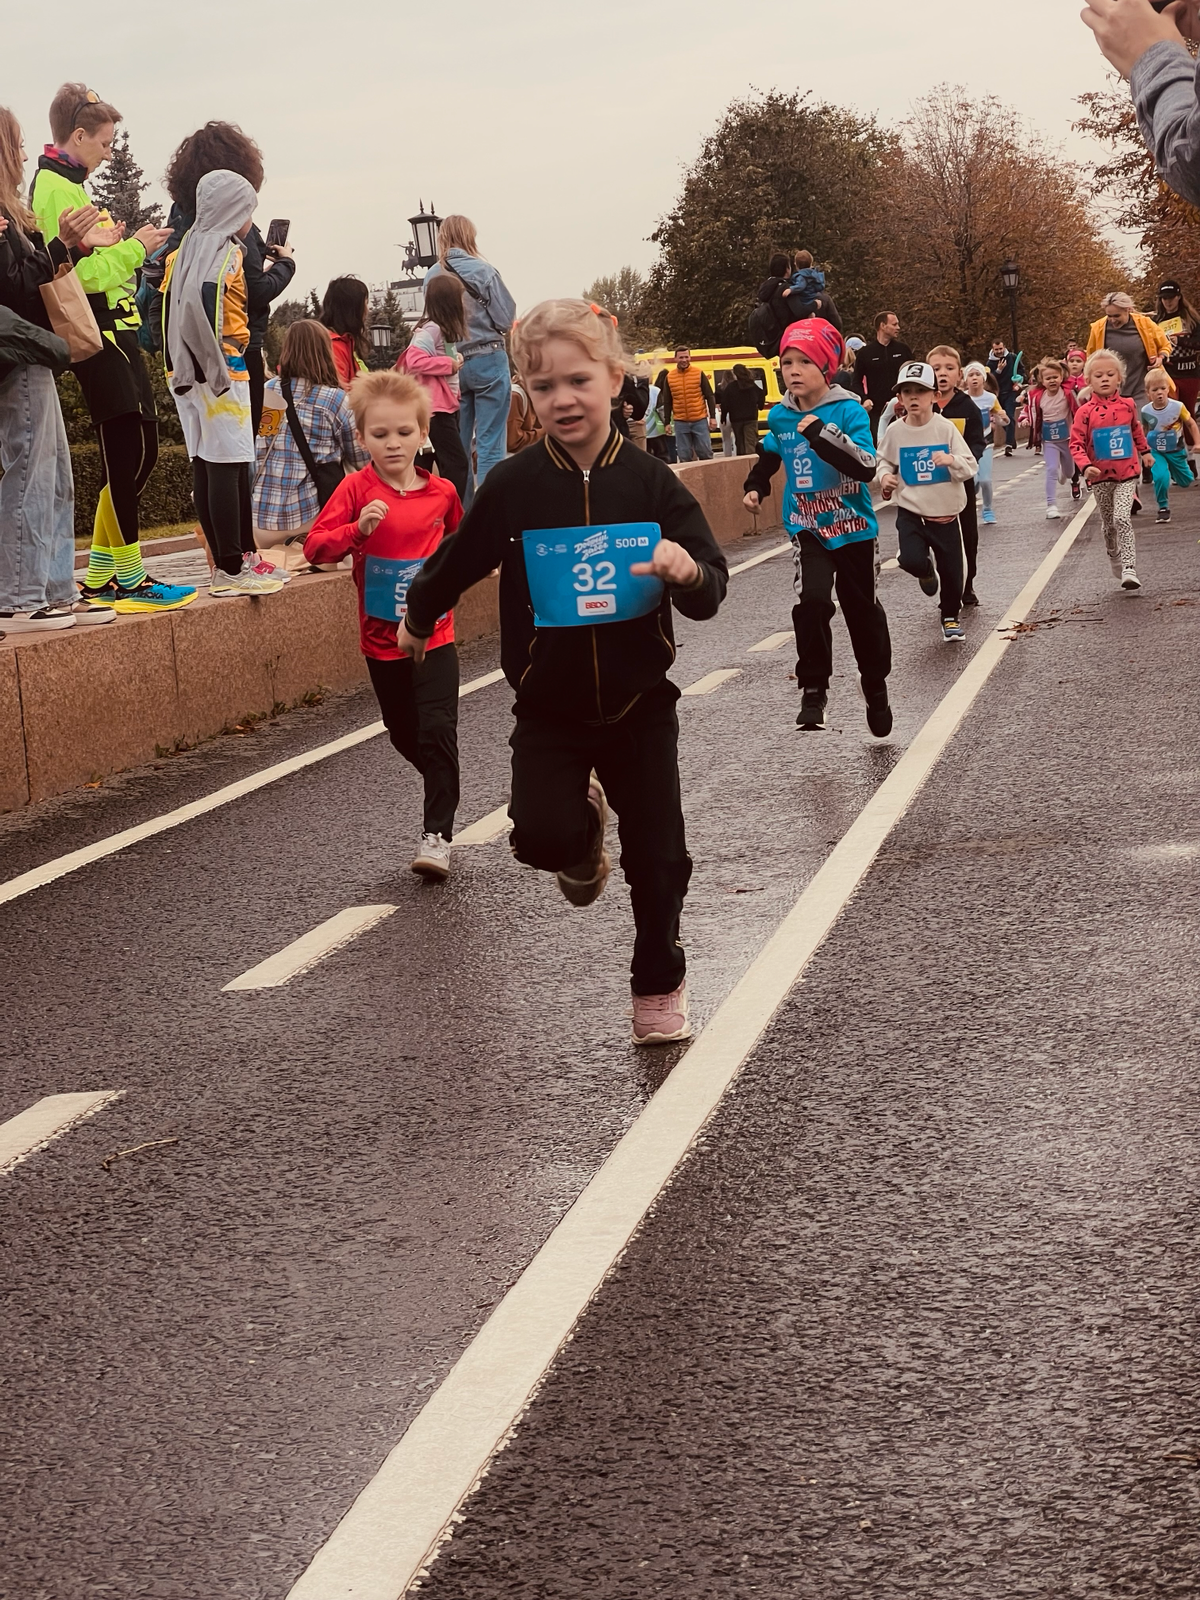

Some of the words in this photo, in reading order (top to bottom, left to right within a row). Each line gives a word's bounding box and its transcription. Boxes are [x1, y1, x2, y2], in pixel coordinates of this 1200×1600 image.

[1109, 438, 1124, 449] 87
[1156, 438, 1167, 446] 53
[793, 458, 813, 475] 92
[912, 460, 936, 472] 109
[615, 537, 637, 548] 500
[572, 561, 617, 592] 32
